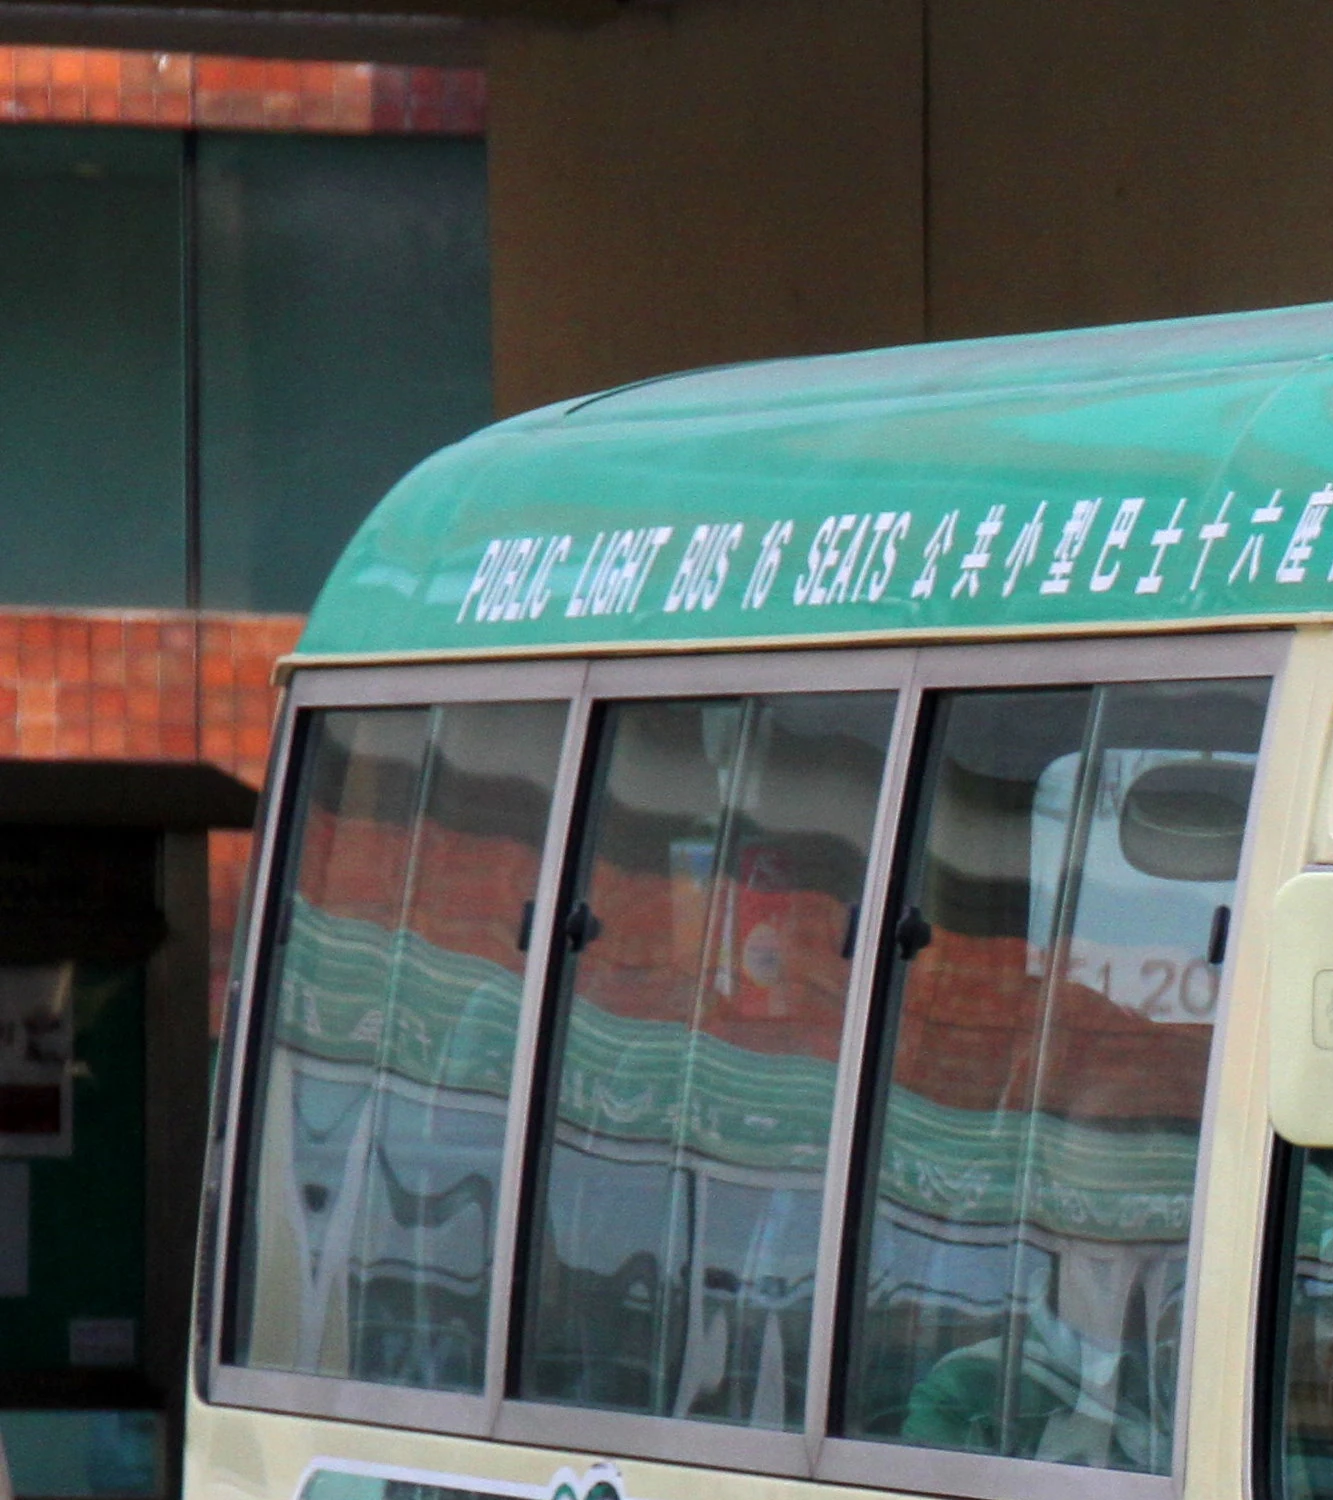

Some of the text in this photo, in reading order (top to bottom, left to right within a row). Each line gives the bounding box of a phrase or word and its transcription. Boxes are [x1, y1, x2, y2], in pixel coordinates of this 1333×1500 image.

[456, 534, 573, 624] PUBLIC
[565, 526, 674, 618] LIGHT
[663, 522, 744, 613] BUS
[741, 519, 794, 610] 16
[793, 511, 912, 607] SEATS
